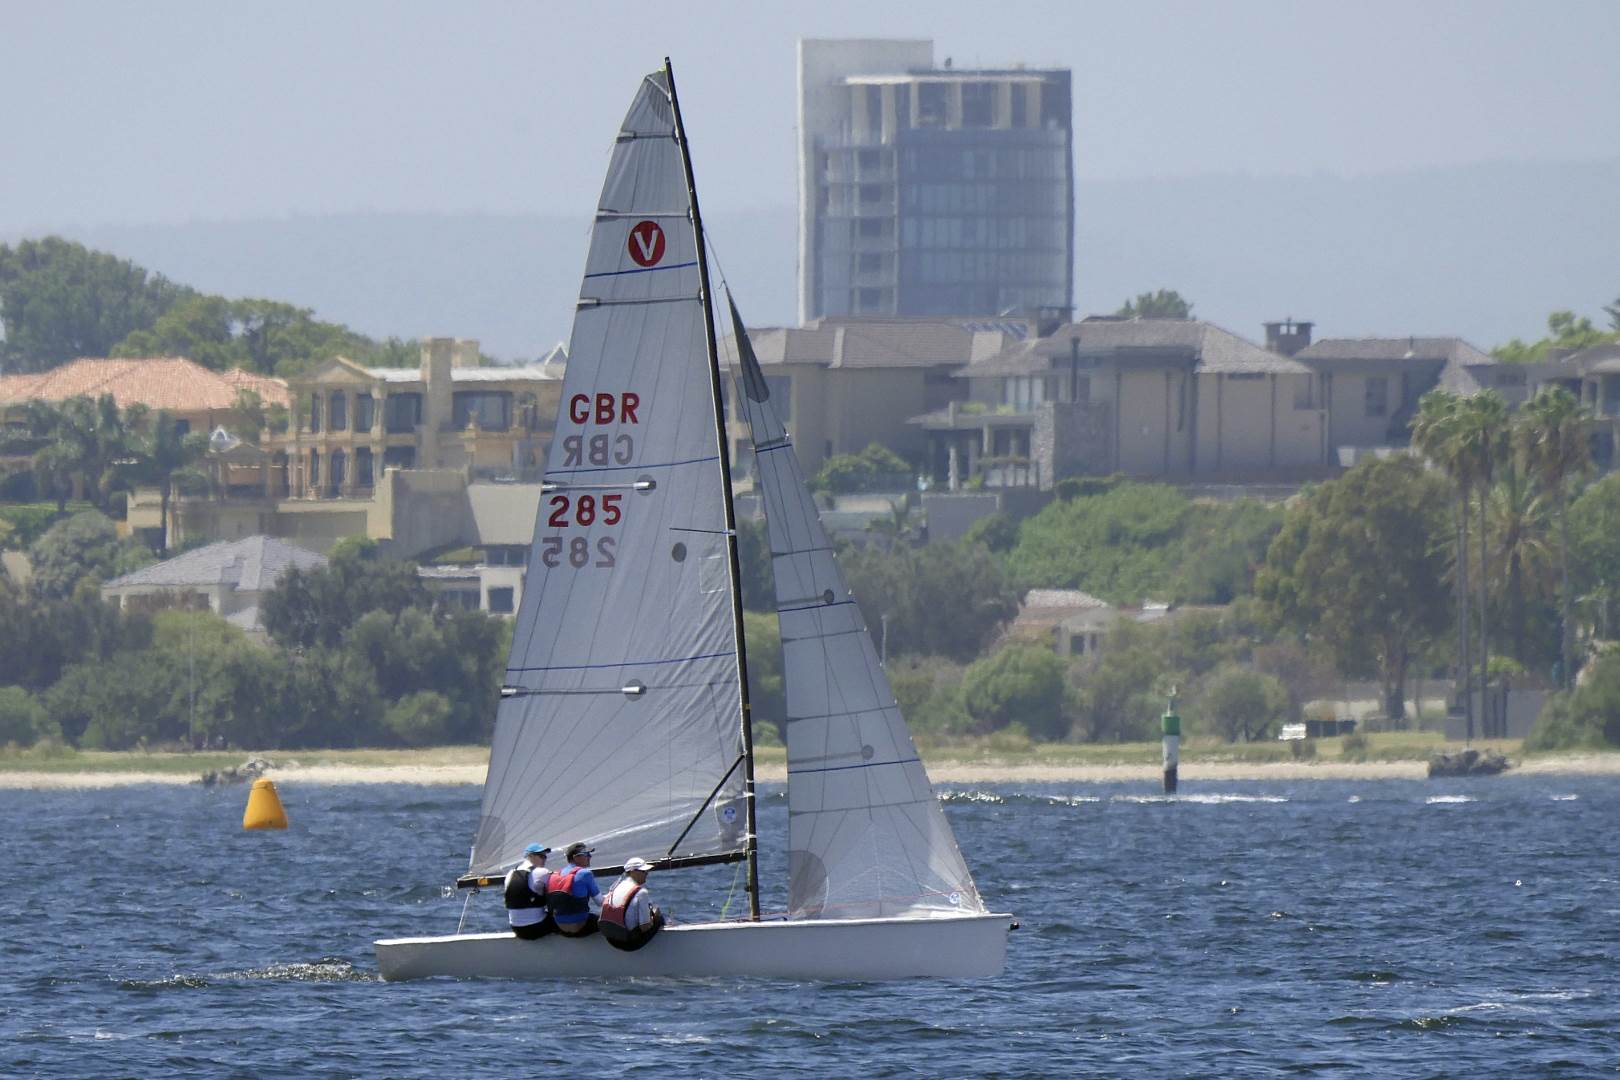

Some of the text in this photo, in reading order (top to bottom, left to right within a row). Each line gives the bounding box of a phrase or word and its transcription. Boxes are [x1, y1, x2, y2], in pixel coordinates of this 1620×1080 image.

[634, 230, 658, 261] V
[570, 393, 640, 425] GBR
[548, 495, 622, 528] 285
